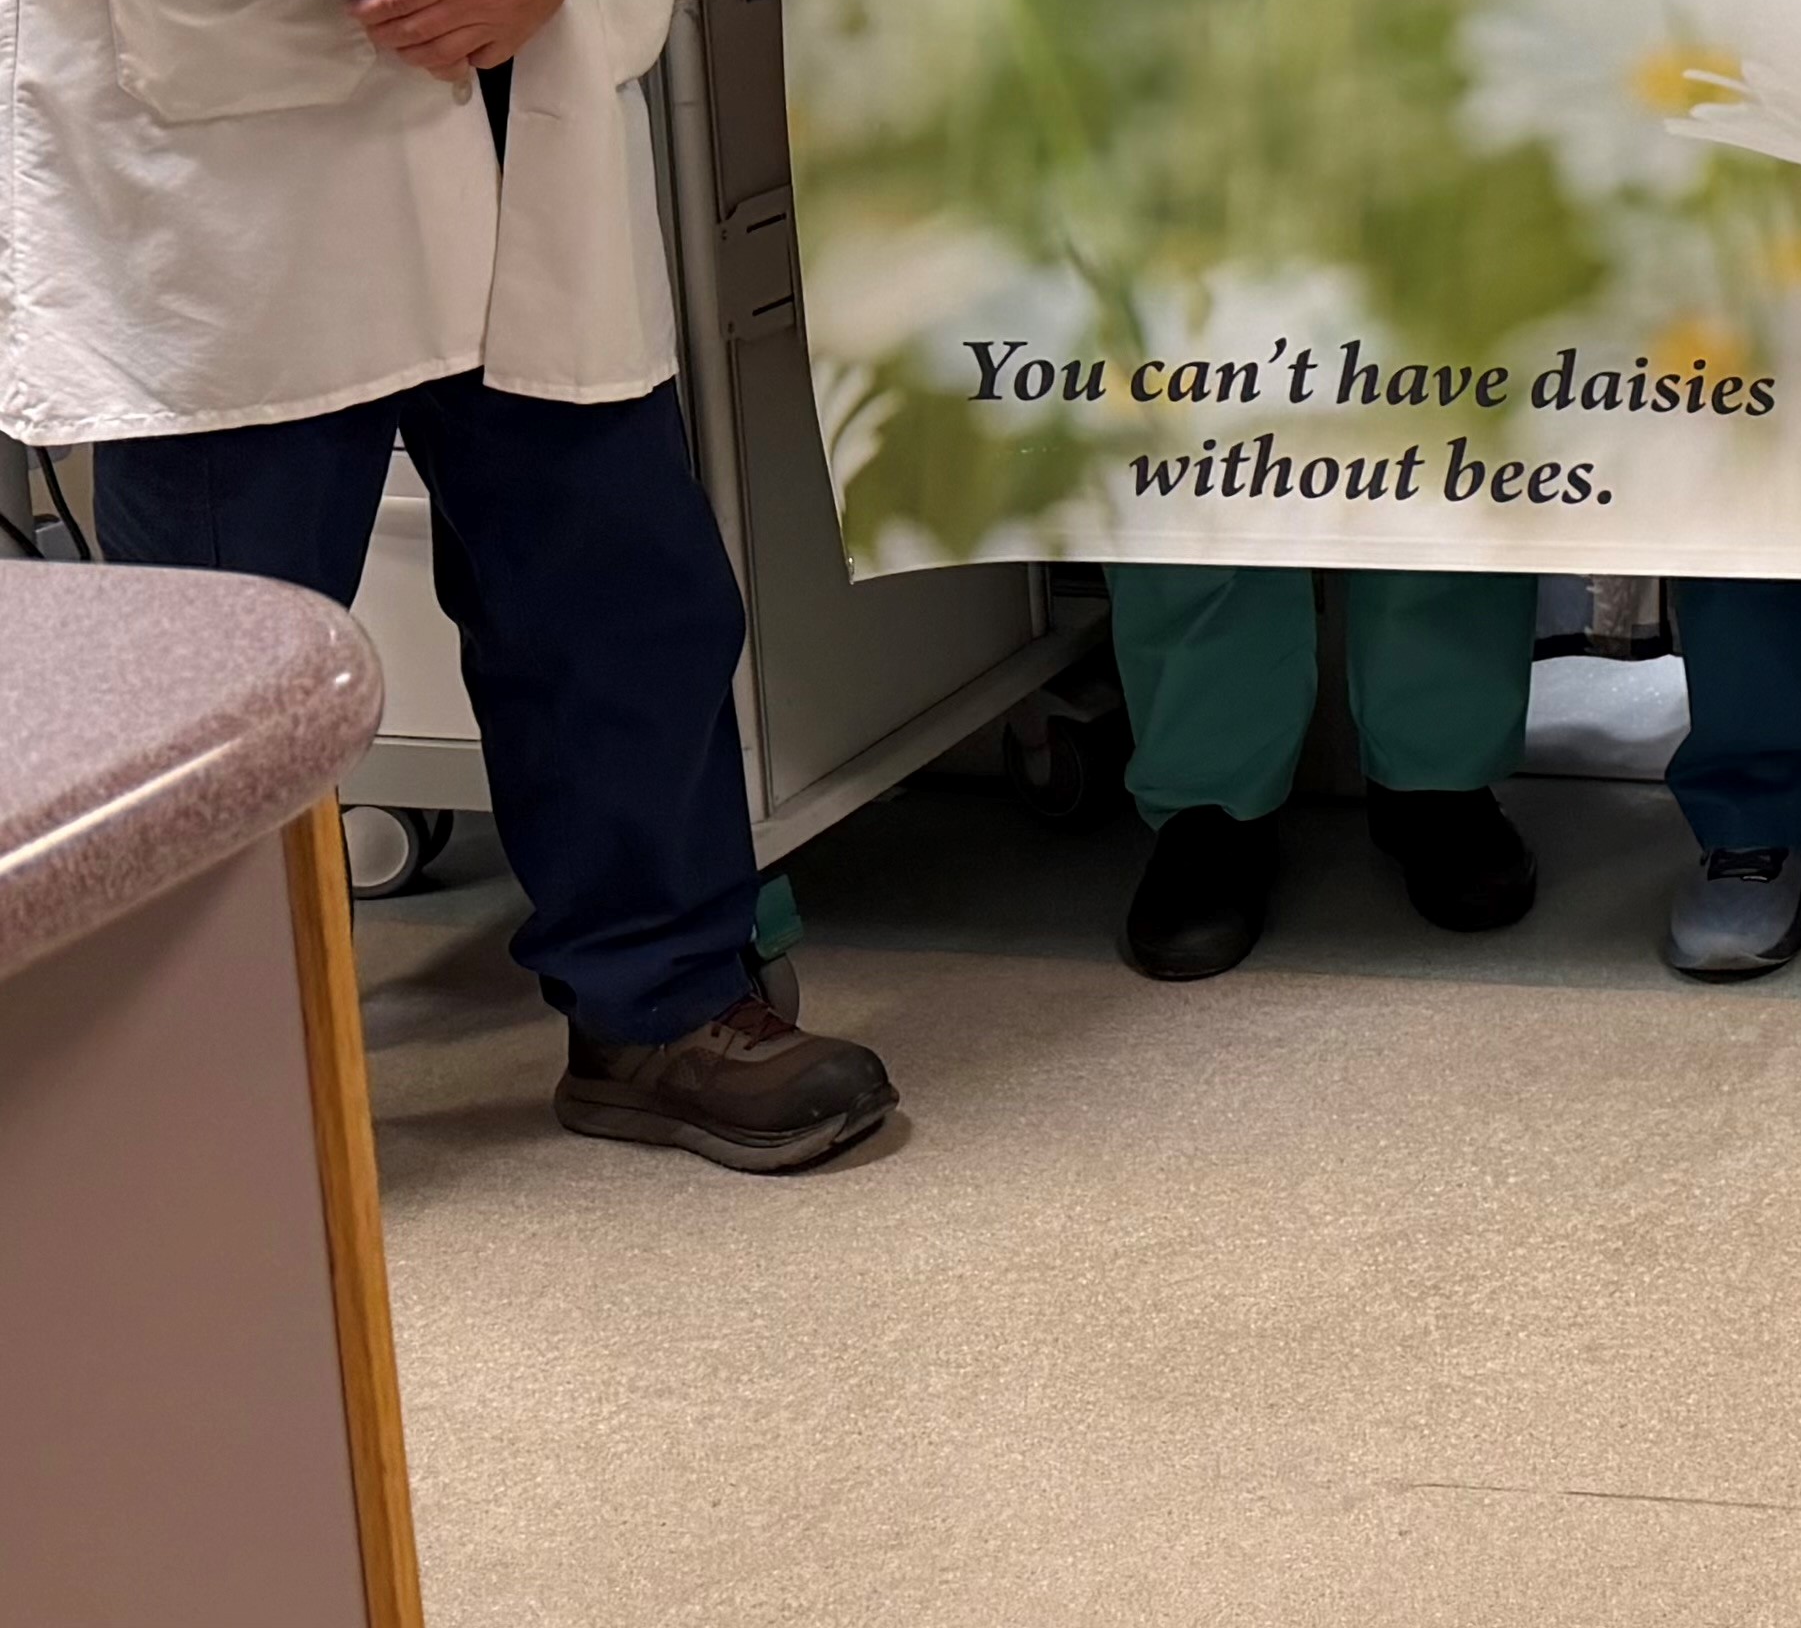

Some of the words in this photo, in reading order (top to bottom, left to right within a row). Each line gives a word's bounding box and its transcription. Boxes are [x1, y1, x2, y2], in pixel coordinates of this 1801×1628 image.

[963, 341, 1106, 401] You
[1336, 340, 1508, 408] have
[1531, 348, 1775, 416] daisies
[1131, 433, 1425, 500] without
[1444, 436, 1612, 504] bees.
